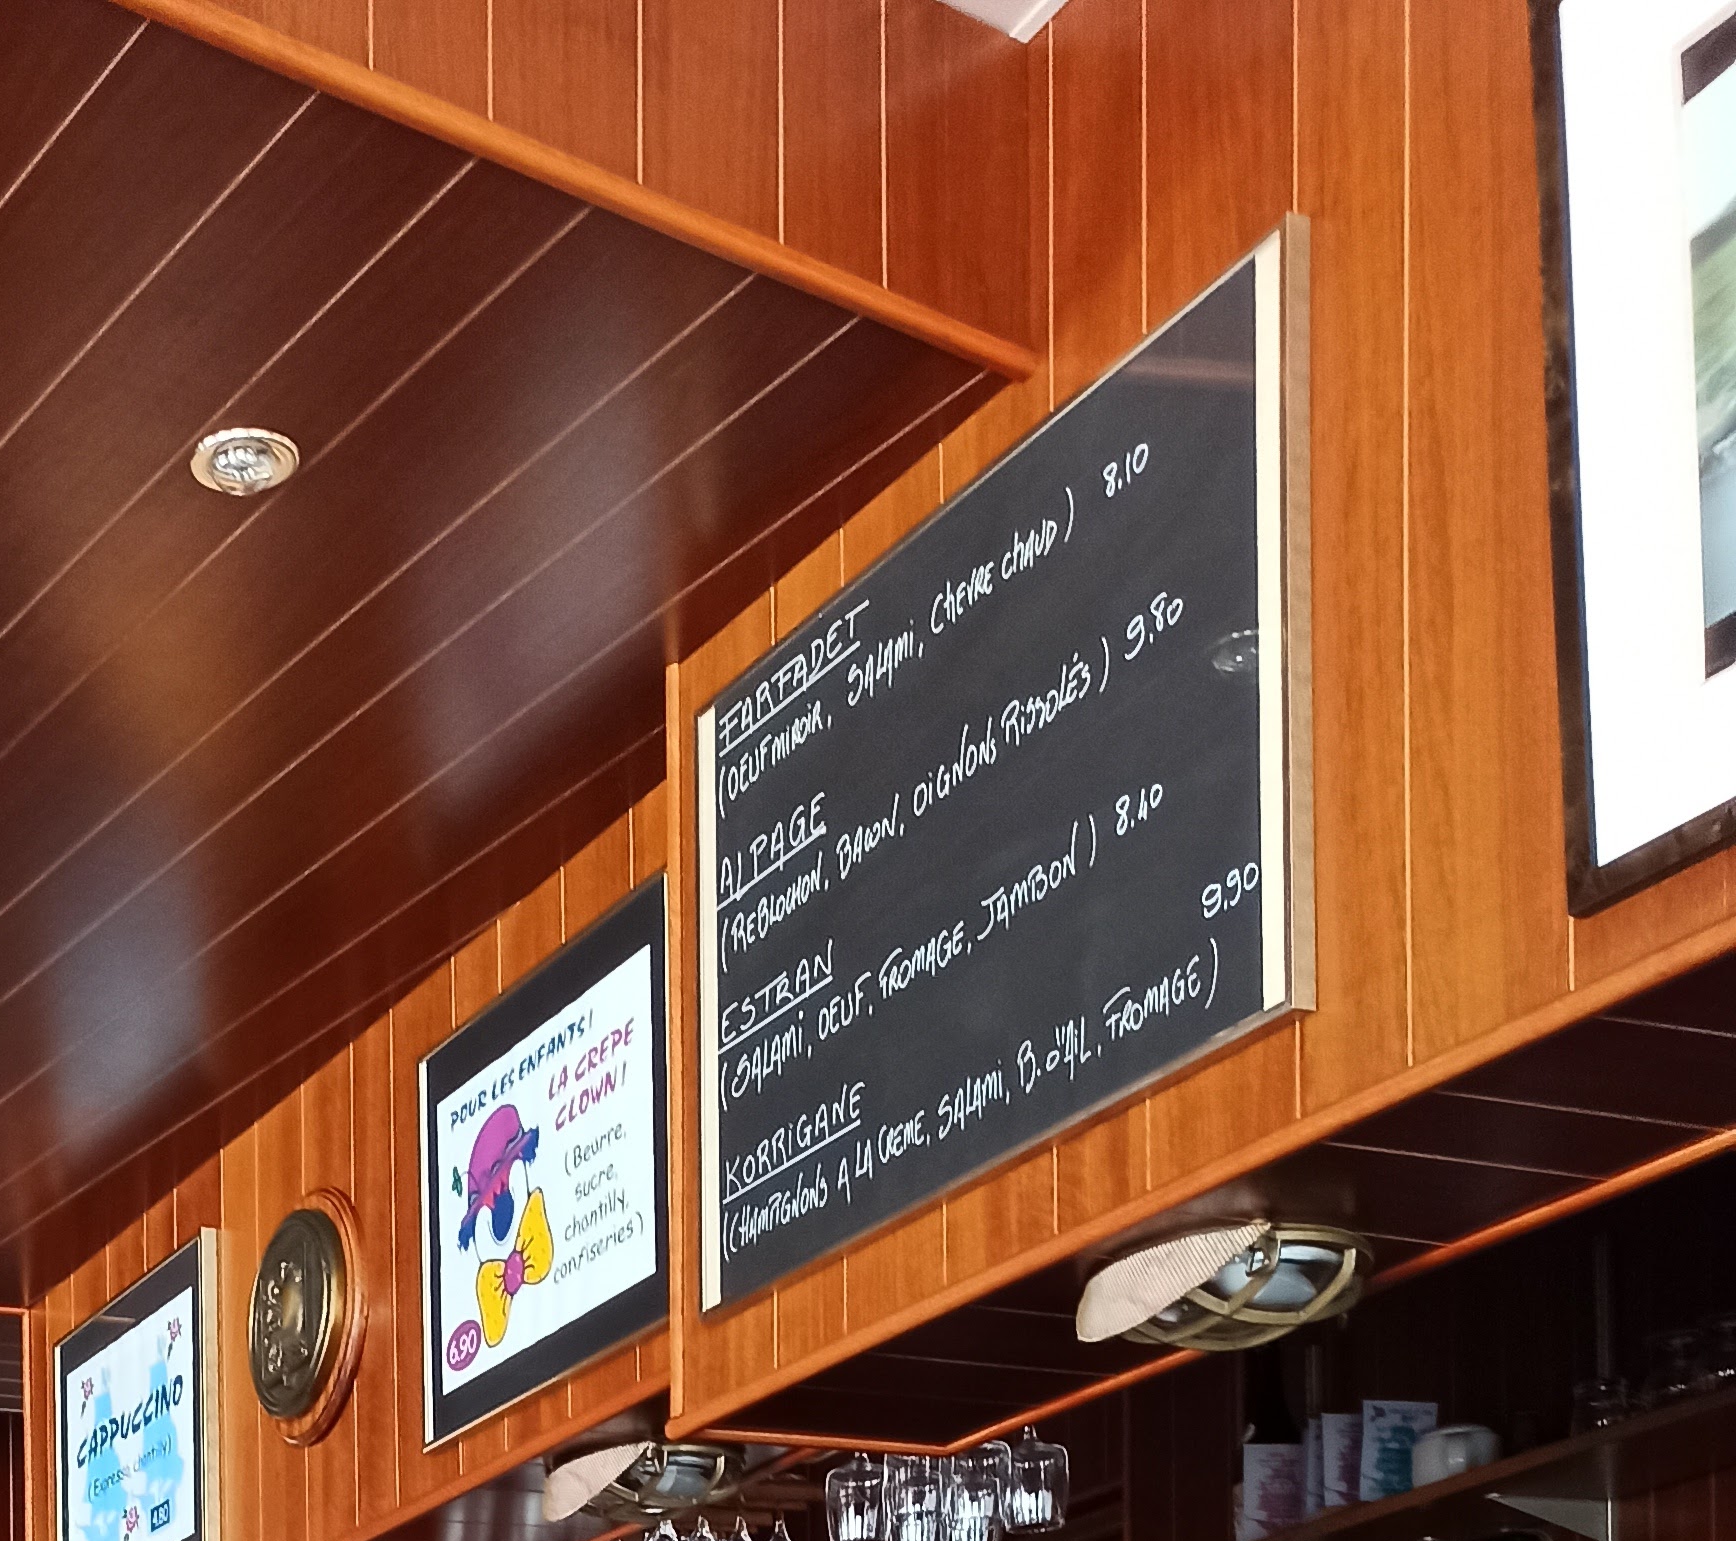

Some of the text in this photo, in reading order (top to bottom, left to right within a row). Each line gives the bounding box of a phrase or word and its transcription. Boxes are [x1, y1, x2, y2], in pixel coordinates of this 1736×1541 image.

[719, 600, 870, 748] FARFADET
[720, 791, 826, 901] ALPAGE
[721, 938, 833, 1043] ESTRAN
[450, 1087, 487, 1132] POUR
[491, 1067, 515, 1101] LES
[548, 1016, 635, 1101] LA CREPE
[725, 1081, 865, 1202] KORRIGANE
[837, 1157, 852, 1206] A
[855, 1138, 873, 1181] LA
[76, 1374, 183, 1469] CAPPUCCINO
